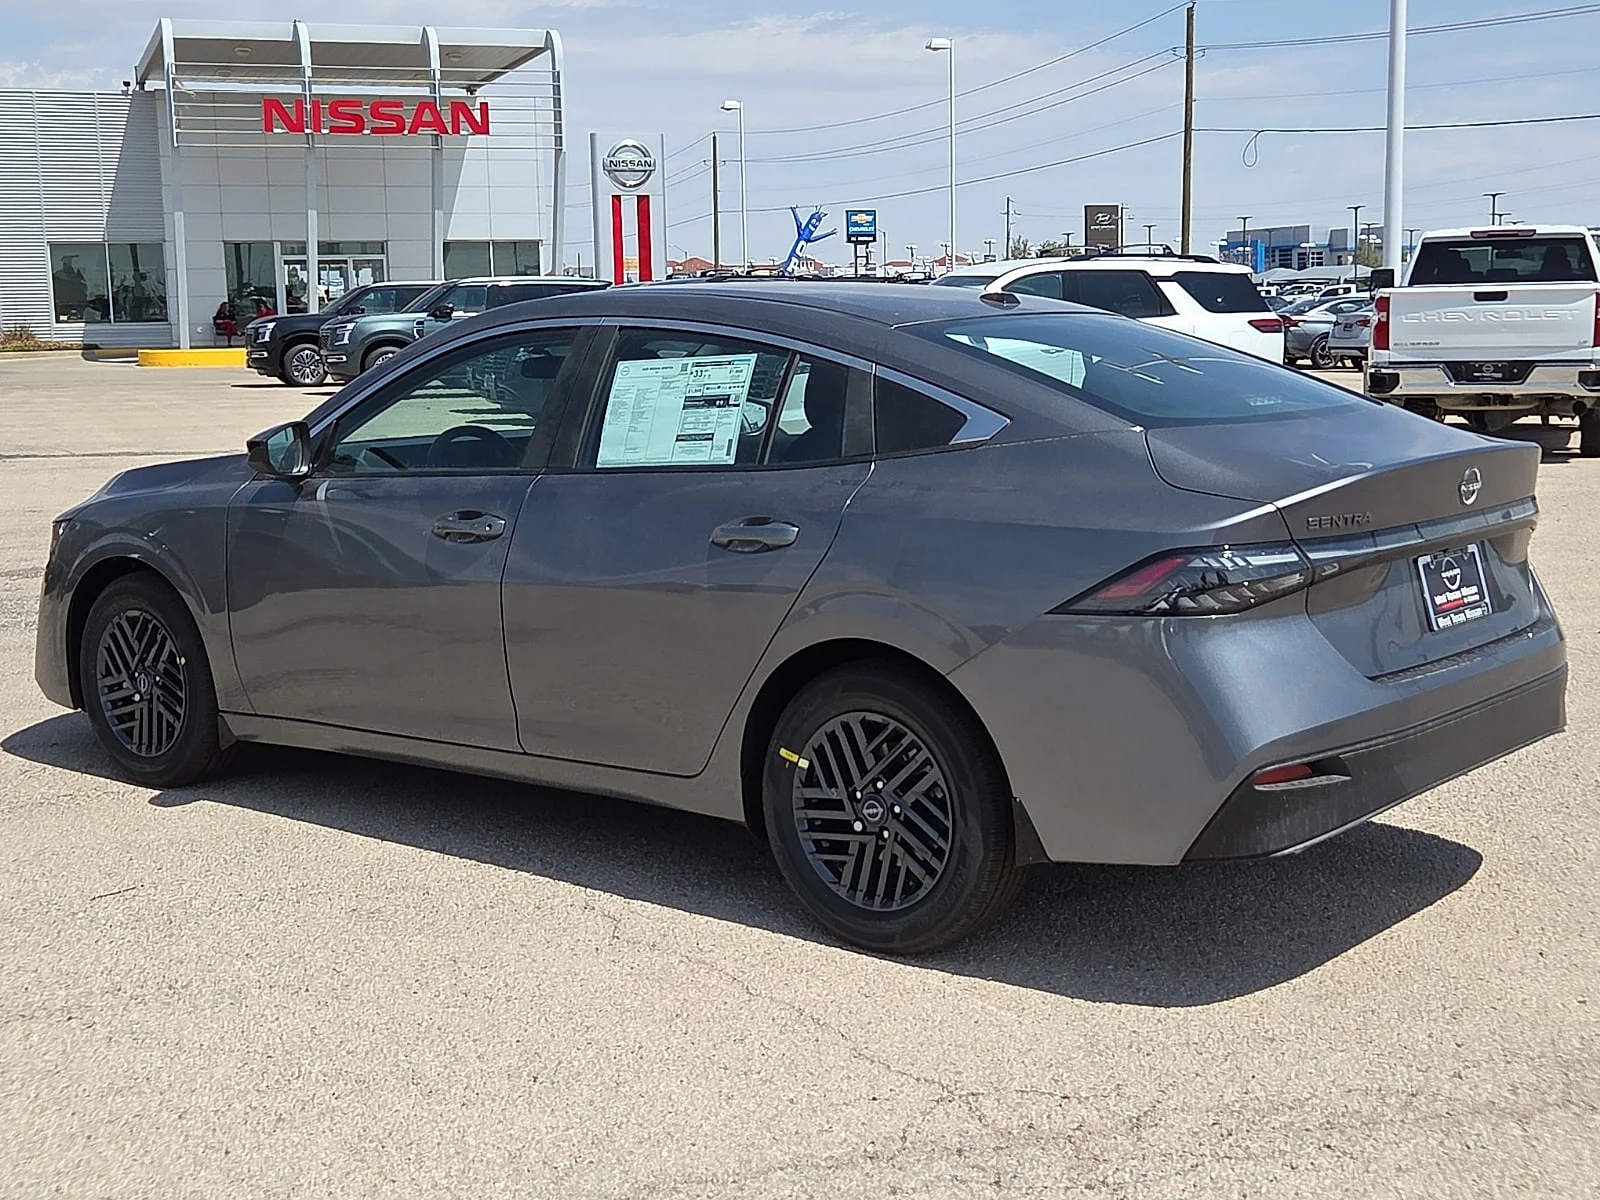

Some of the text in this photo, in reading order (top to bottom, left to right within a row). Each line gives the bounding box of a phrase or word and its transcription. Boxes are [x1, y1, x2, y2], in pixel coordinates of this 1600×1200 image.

[262, 98, 490, 135] NISSAN
[609, 159, 652, 168] NISSAN
[1400, 308, 1581, 323] CHEVROLET
[1306, 512, 1372, 530] SENTRA
